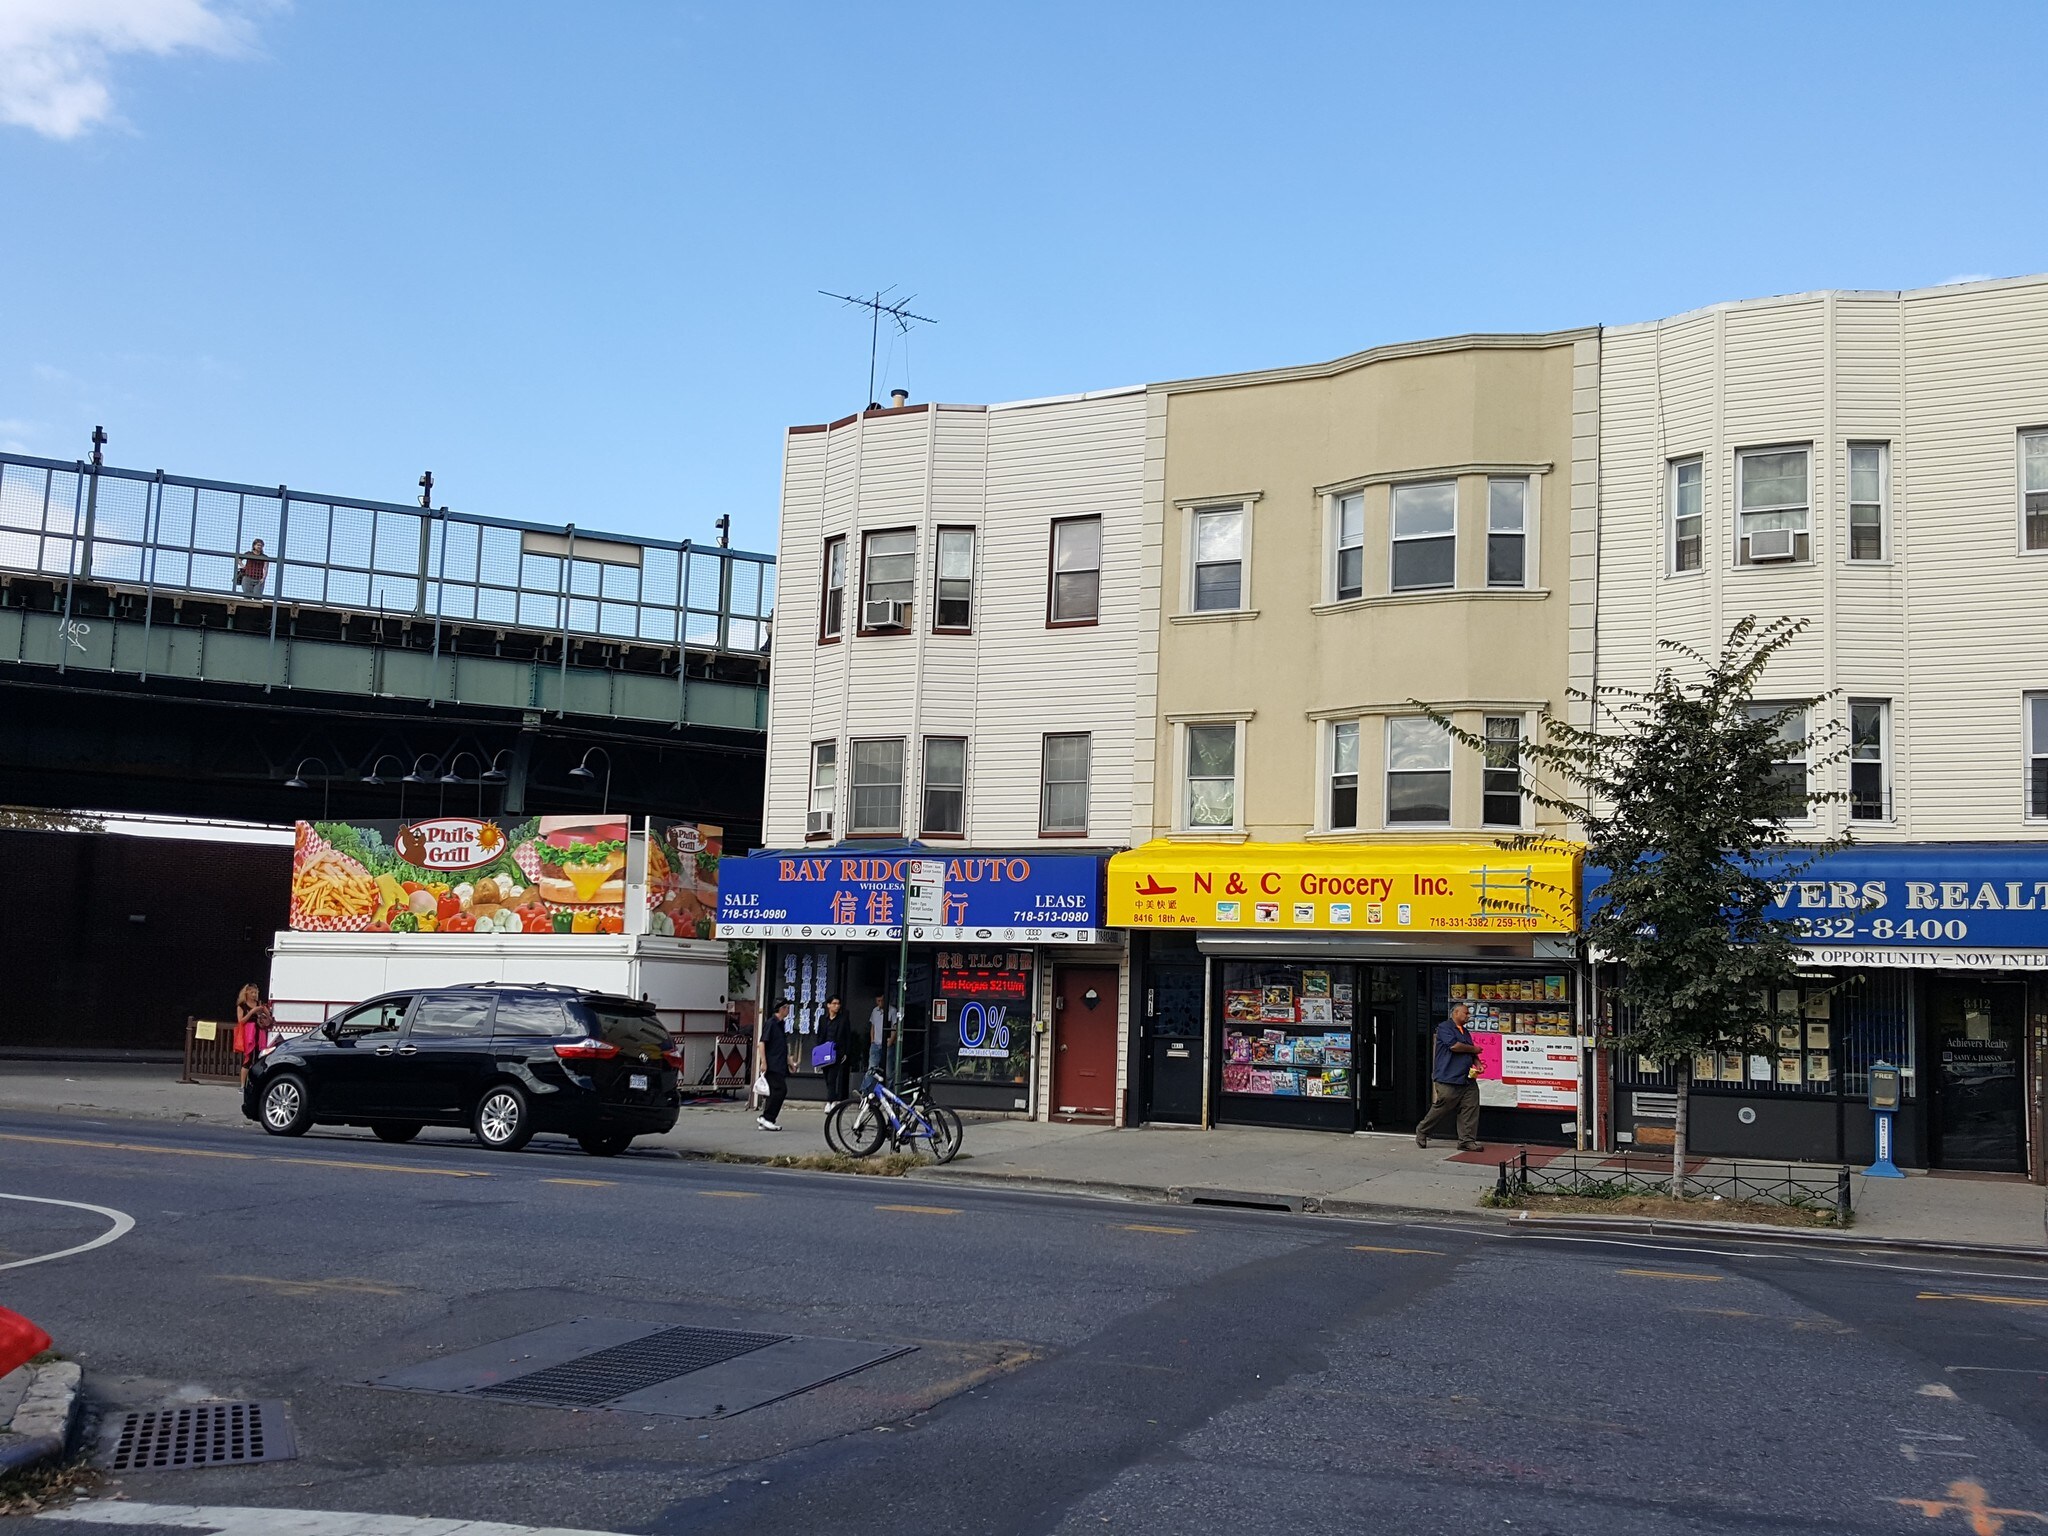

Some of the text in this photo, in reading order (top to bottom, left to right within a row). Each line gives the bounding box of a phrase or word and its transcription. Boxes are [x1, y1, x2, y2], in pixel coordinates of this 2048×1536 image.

[426, 827, 474, 843] Phil's
[680, 840, 695, 850] Grill
[429, 847, 470, 862] Grill
[778, 859, 832, 882] BAY
[944, 858, 1031, 882] AUTO
[860, 882, 905, 891] WHOLESA
[913, 886, 918, 897] 1
[1193, 872, 1454, 902] N & C Grocery Inc.
[725, 894, 759, 906] SALE
[1765, 881, 1888, 909] VERS
[1035, 895, 1086, 908] LEASE
[722, 909, 787, 920] 718-513-0980
[1013, 911, 1089, 923] 718-513-0980
[1133, 914, 1198, 923] 8416 18th Ave.
[1430, 917, 1489, 927] 718-331-3382
[1496, 918, 1537, 928] 259-1119
[1793, 917, 1968, 940] 232-8400
[888, 929, 902, 938] 841
[1963, 999, 1991, 1009] 8412
[959, 1001, 1010, 1049] 0%
[1947, 1037, 2008, 1051] Achievers Realty
